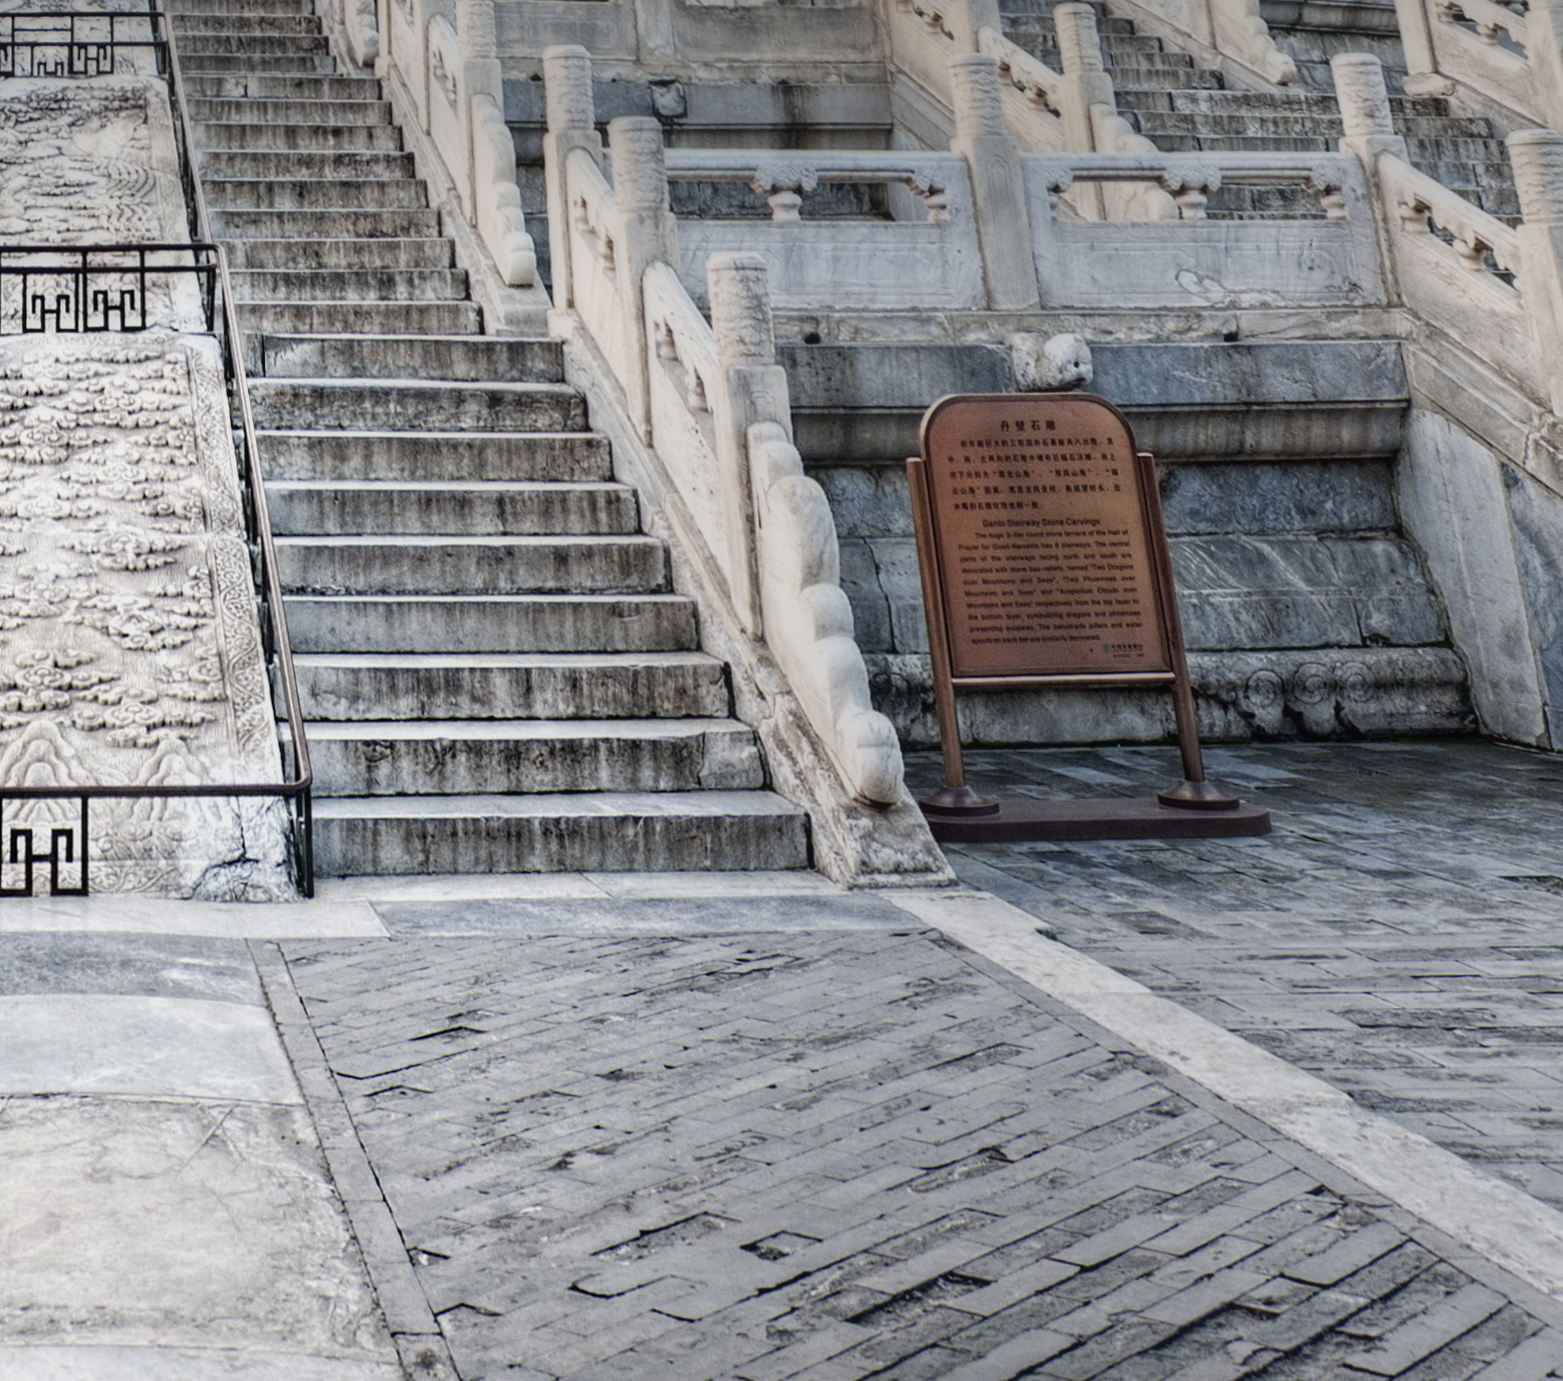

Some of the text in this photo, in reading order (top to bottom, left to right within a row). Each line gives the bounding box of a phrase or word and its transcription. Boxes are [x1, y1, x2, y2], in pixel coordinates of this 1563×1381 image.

[982, 517, 1100, 527] Danbi Stairway Stone Carvings
